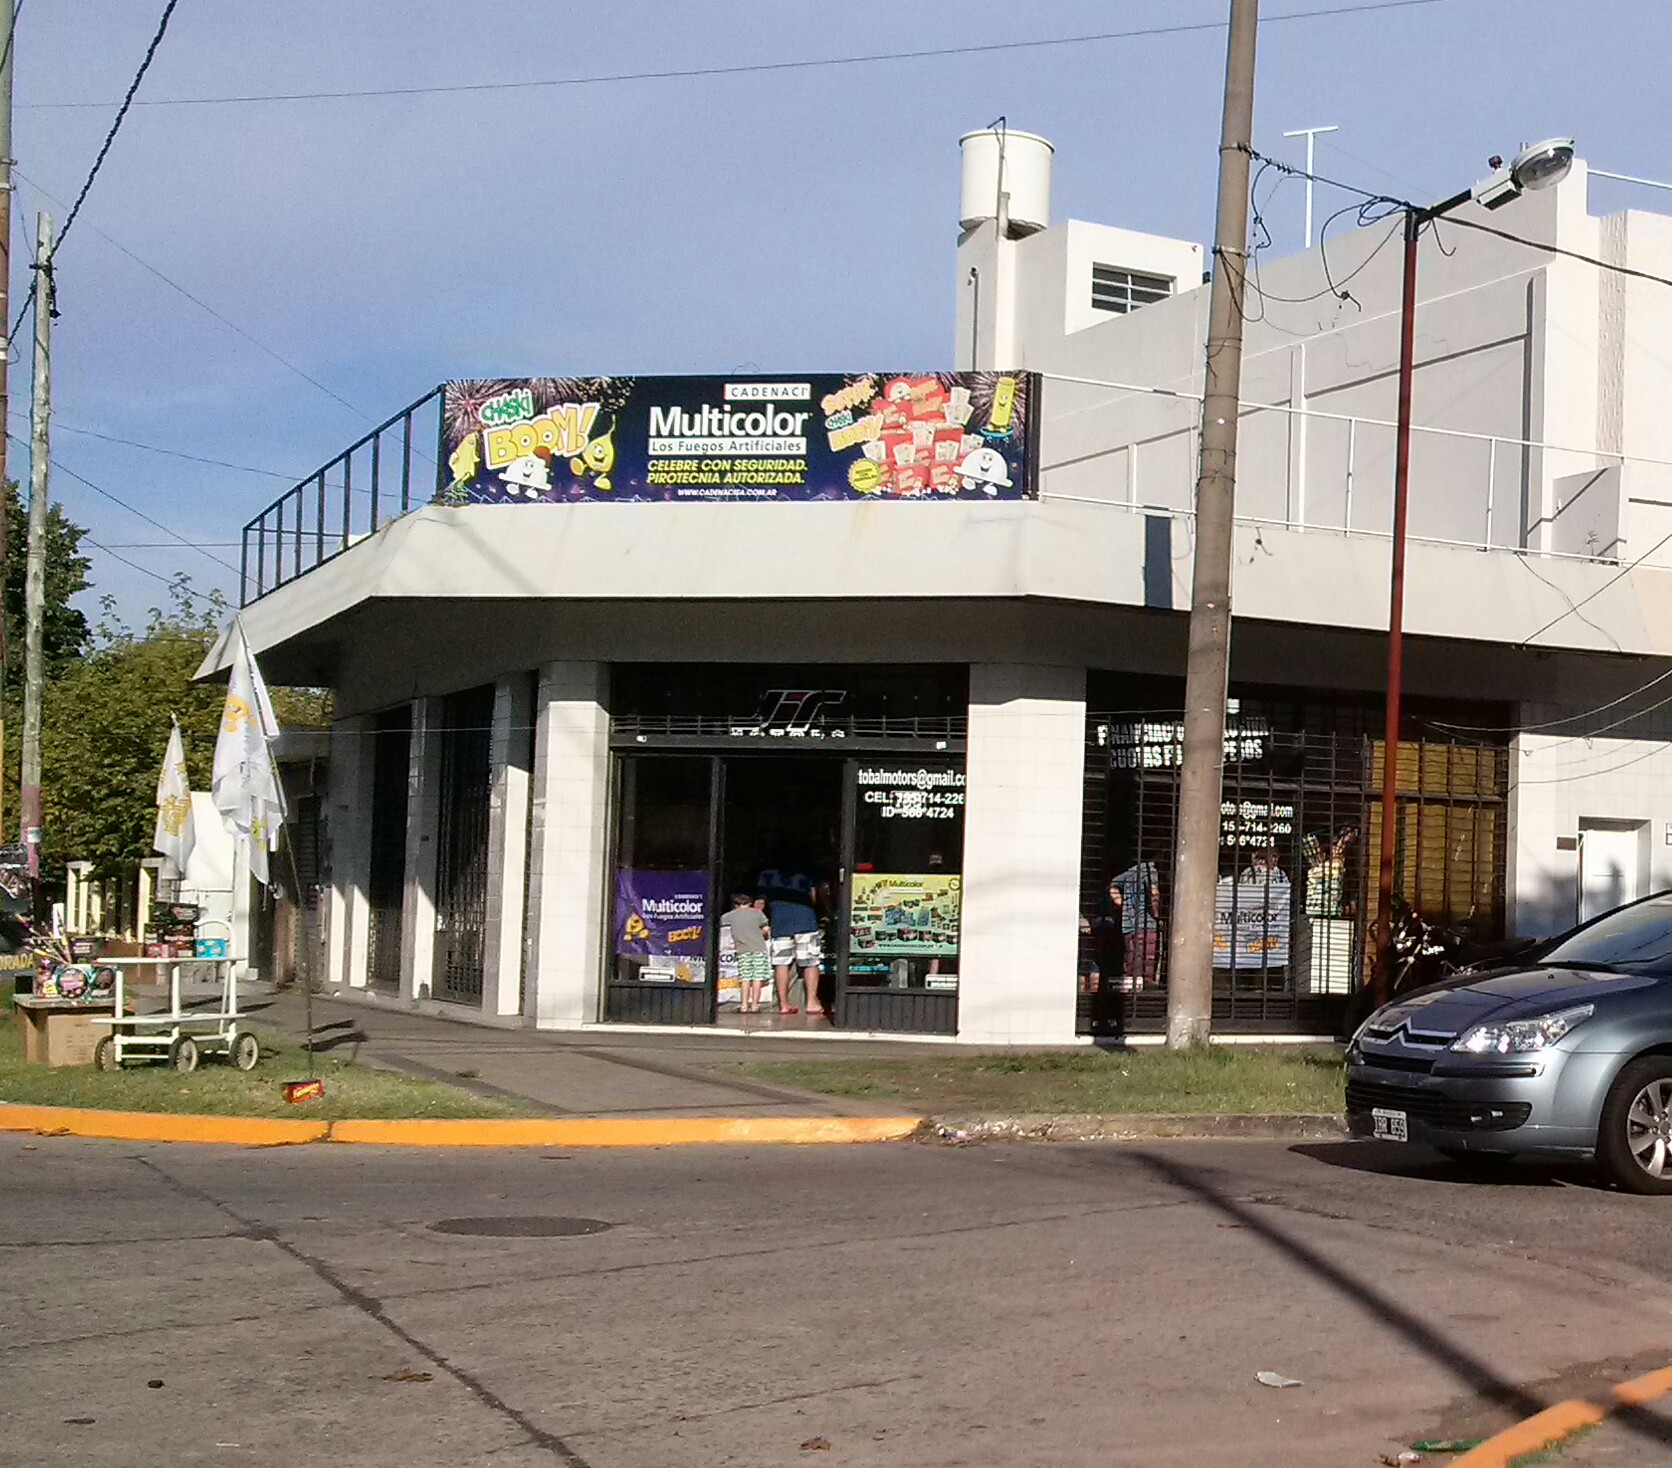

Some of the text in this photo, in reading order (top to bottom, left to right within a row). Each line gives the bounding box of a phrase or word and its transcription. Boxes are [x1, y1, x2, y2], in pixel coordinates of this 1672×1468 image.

[731, 387, 806, 397] CADENACI
[650, 404, 809, 436] Multicolor
[487, 406, 597, 466] BOOM!
[652, 440, 802, 455] Los Fuegos Artificiales
[648, 459, 808, 471] CELEBRE CON SEGURIDAD.
[647, 472, 805, 484] PIROTECNIA AUTORIZADA.
[642, 898, 703, 913] Multicolor
